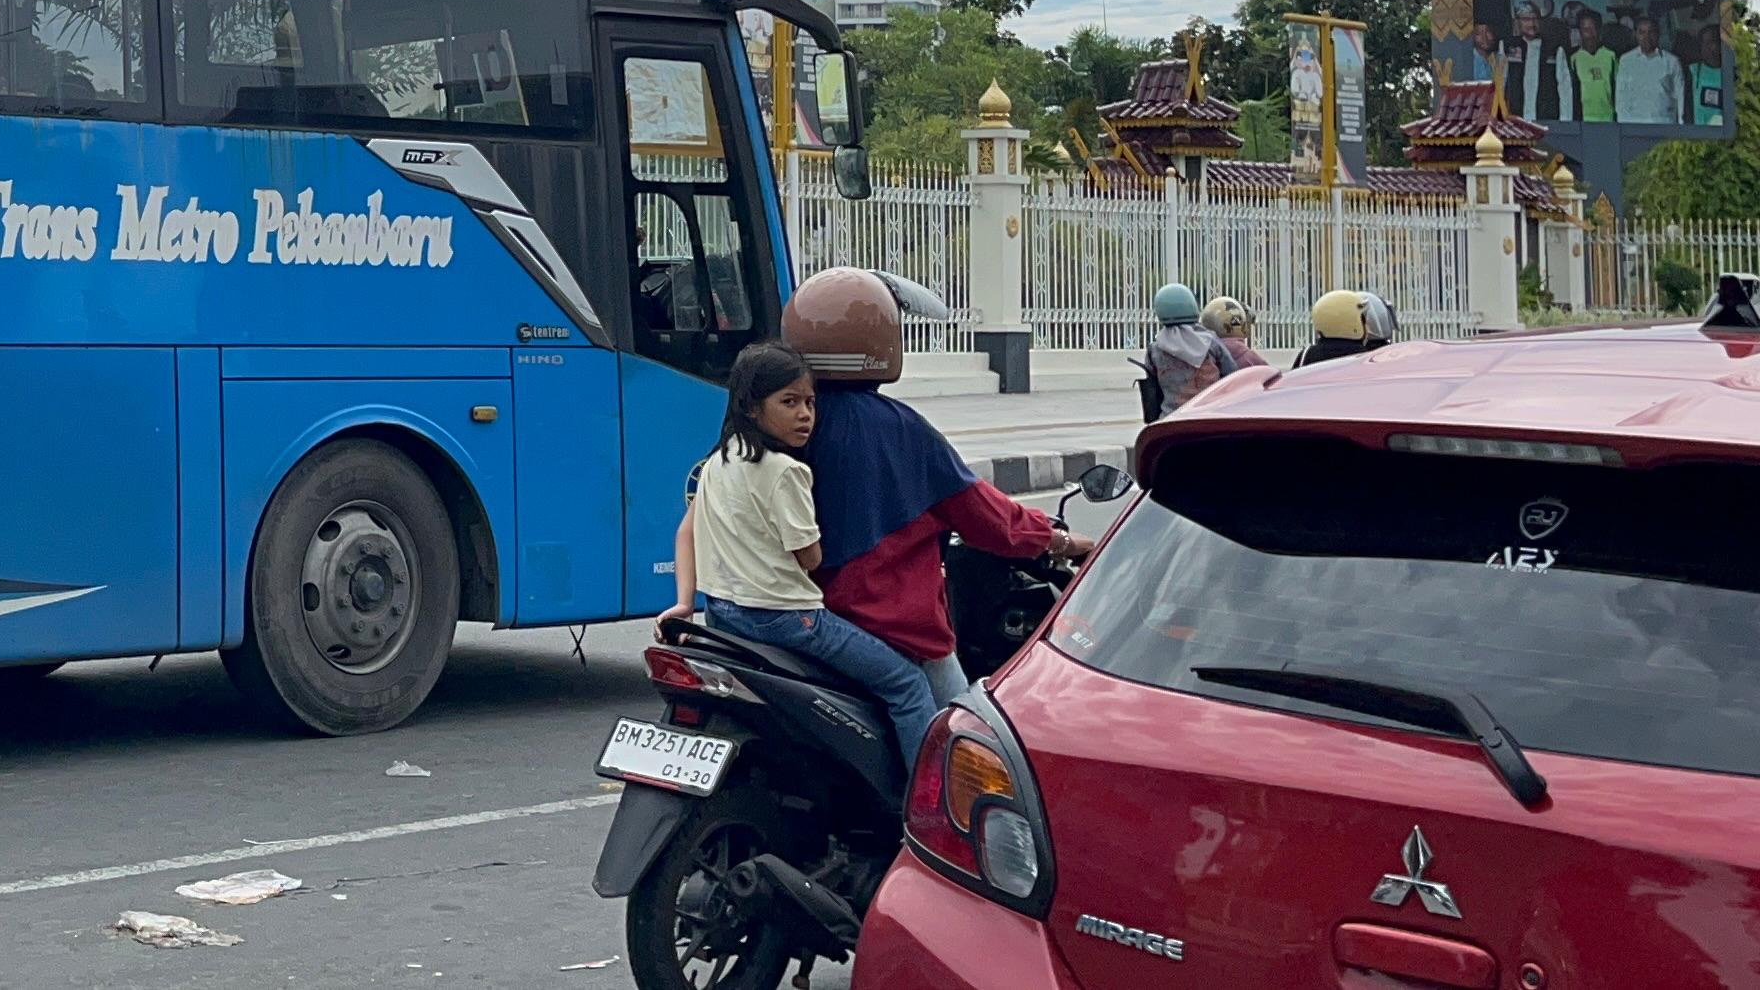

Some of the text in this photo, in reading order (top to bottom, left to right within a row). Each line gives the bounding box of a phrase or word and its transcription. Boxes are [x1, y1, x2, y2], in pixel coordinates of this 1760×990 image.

[110, 183, 240, 264] Metro
[247, 186, 454, 268] Pekanbaru
[517, 354, 564, 365] HINO
[614, 723, 727, 764] BM 3251 ACE
[1076, 913, 1184, 961] MIRAGE
